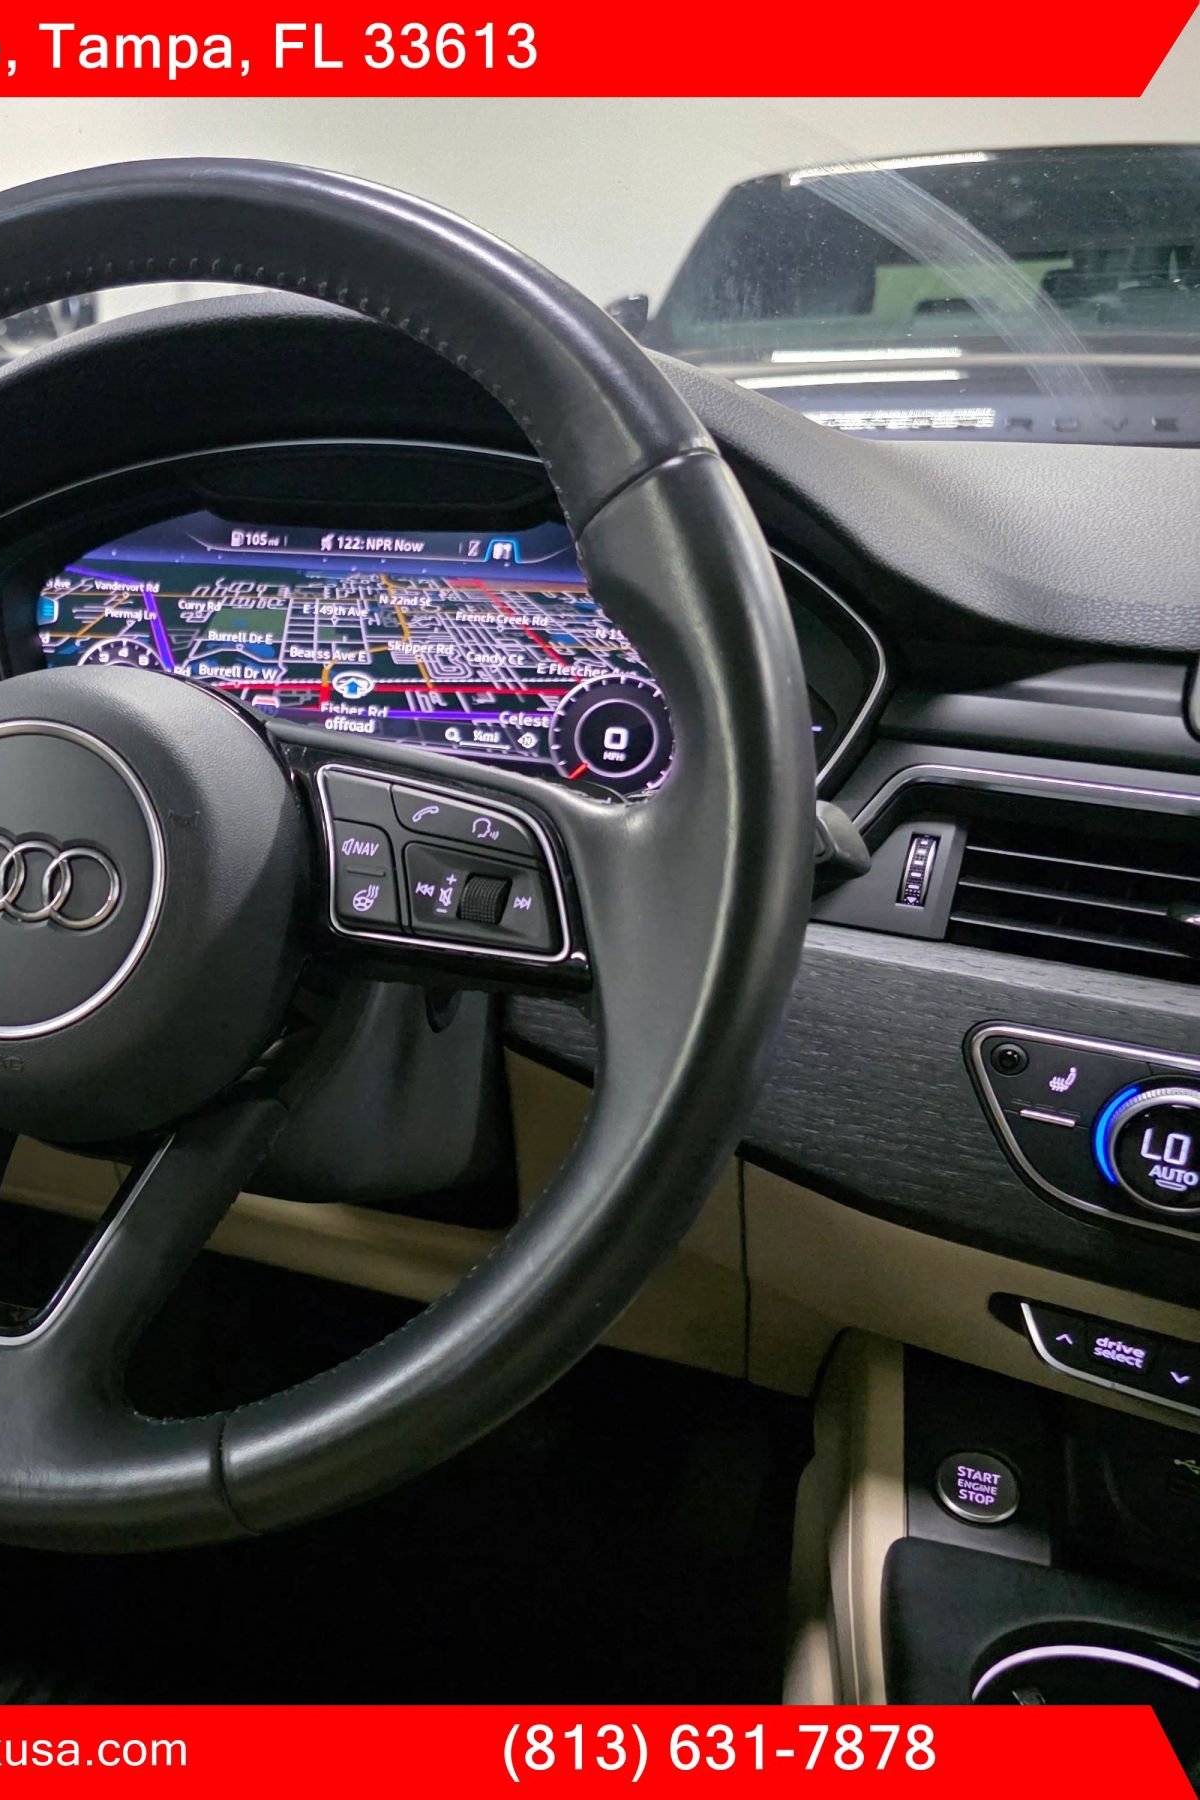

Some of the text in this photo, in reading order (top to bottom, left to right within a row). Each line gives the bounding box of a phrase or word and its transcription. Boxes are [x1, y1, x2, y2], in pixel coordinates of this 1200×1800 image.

[337, 536, 425, 553] 122: NPR Now
[94, 580, 160, 593] Vandervort Rd
[178, 600, 220, 614] Curry Rd
[378, 594, 387, 605] N
[423, 597, 432, 607] St
[143, 610, 157, 621] Ln
[303, 605, 368, 618] E 149th Ave
[456, 611, 548, 627] French Creek Rd
[208, 631, 273, 645] Burrell Dr E
[595, 629, 607, 640] N
[387, 641, 454, 656] Skipper Rd
[331, 650, 357, 662] Ave
[358, 651, 368, 663] E
[466, 651, 525, 668] Candy Ct
[199, 665, 278, 681] Burrell Dr W
[536, 664, 546, 675] E
[548, 665, 608, 678] Fletcher
[320, 703, 388, 718] Fisher Rd
[325, 717, 375, 734] offroad
[603, 727, 629, 751] 0
[603, 751, 626, 762] MPH
[352, 841, 379, 856] NAV
[1140, 1127, 1192, 1166] LO
[1148, 1164, 1199, 1186] AUTO
[1095, 1337, 1146, 1358] drive
[1093, 1346, 1144, 1369] select
[957, 1465, 1001, 1486] START
[957, 1478, 997, 1496] ENGINE
[958, 1488, 995, 1506] STOP
